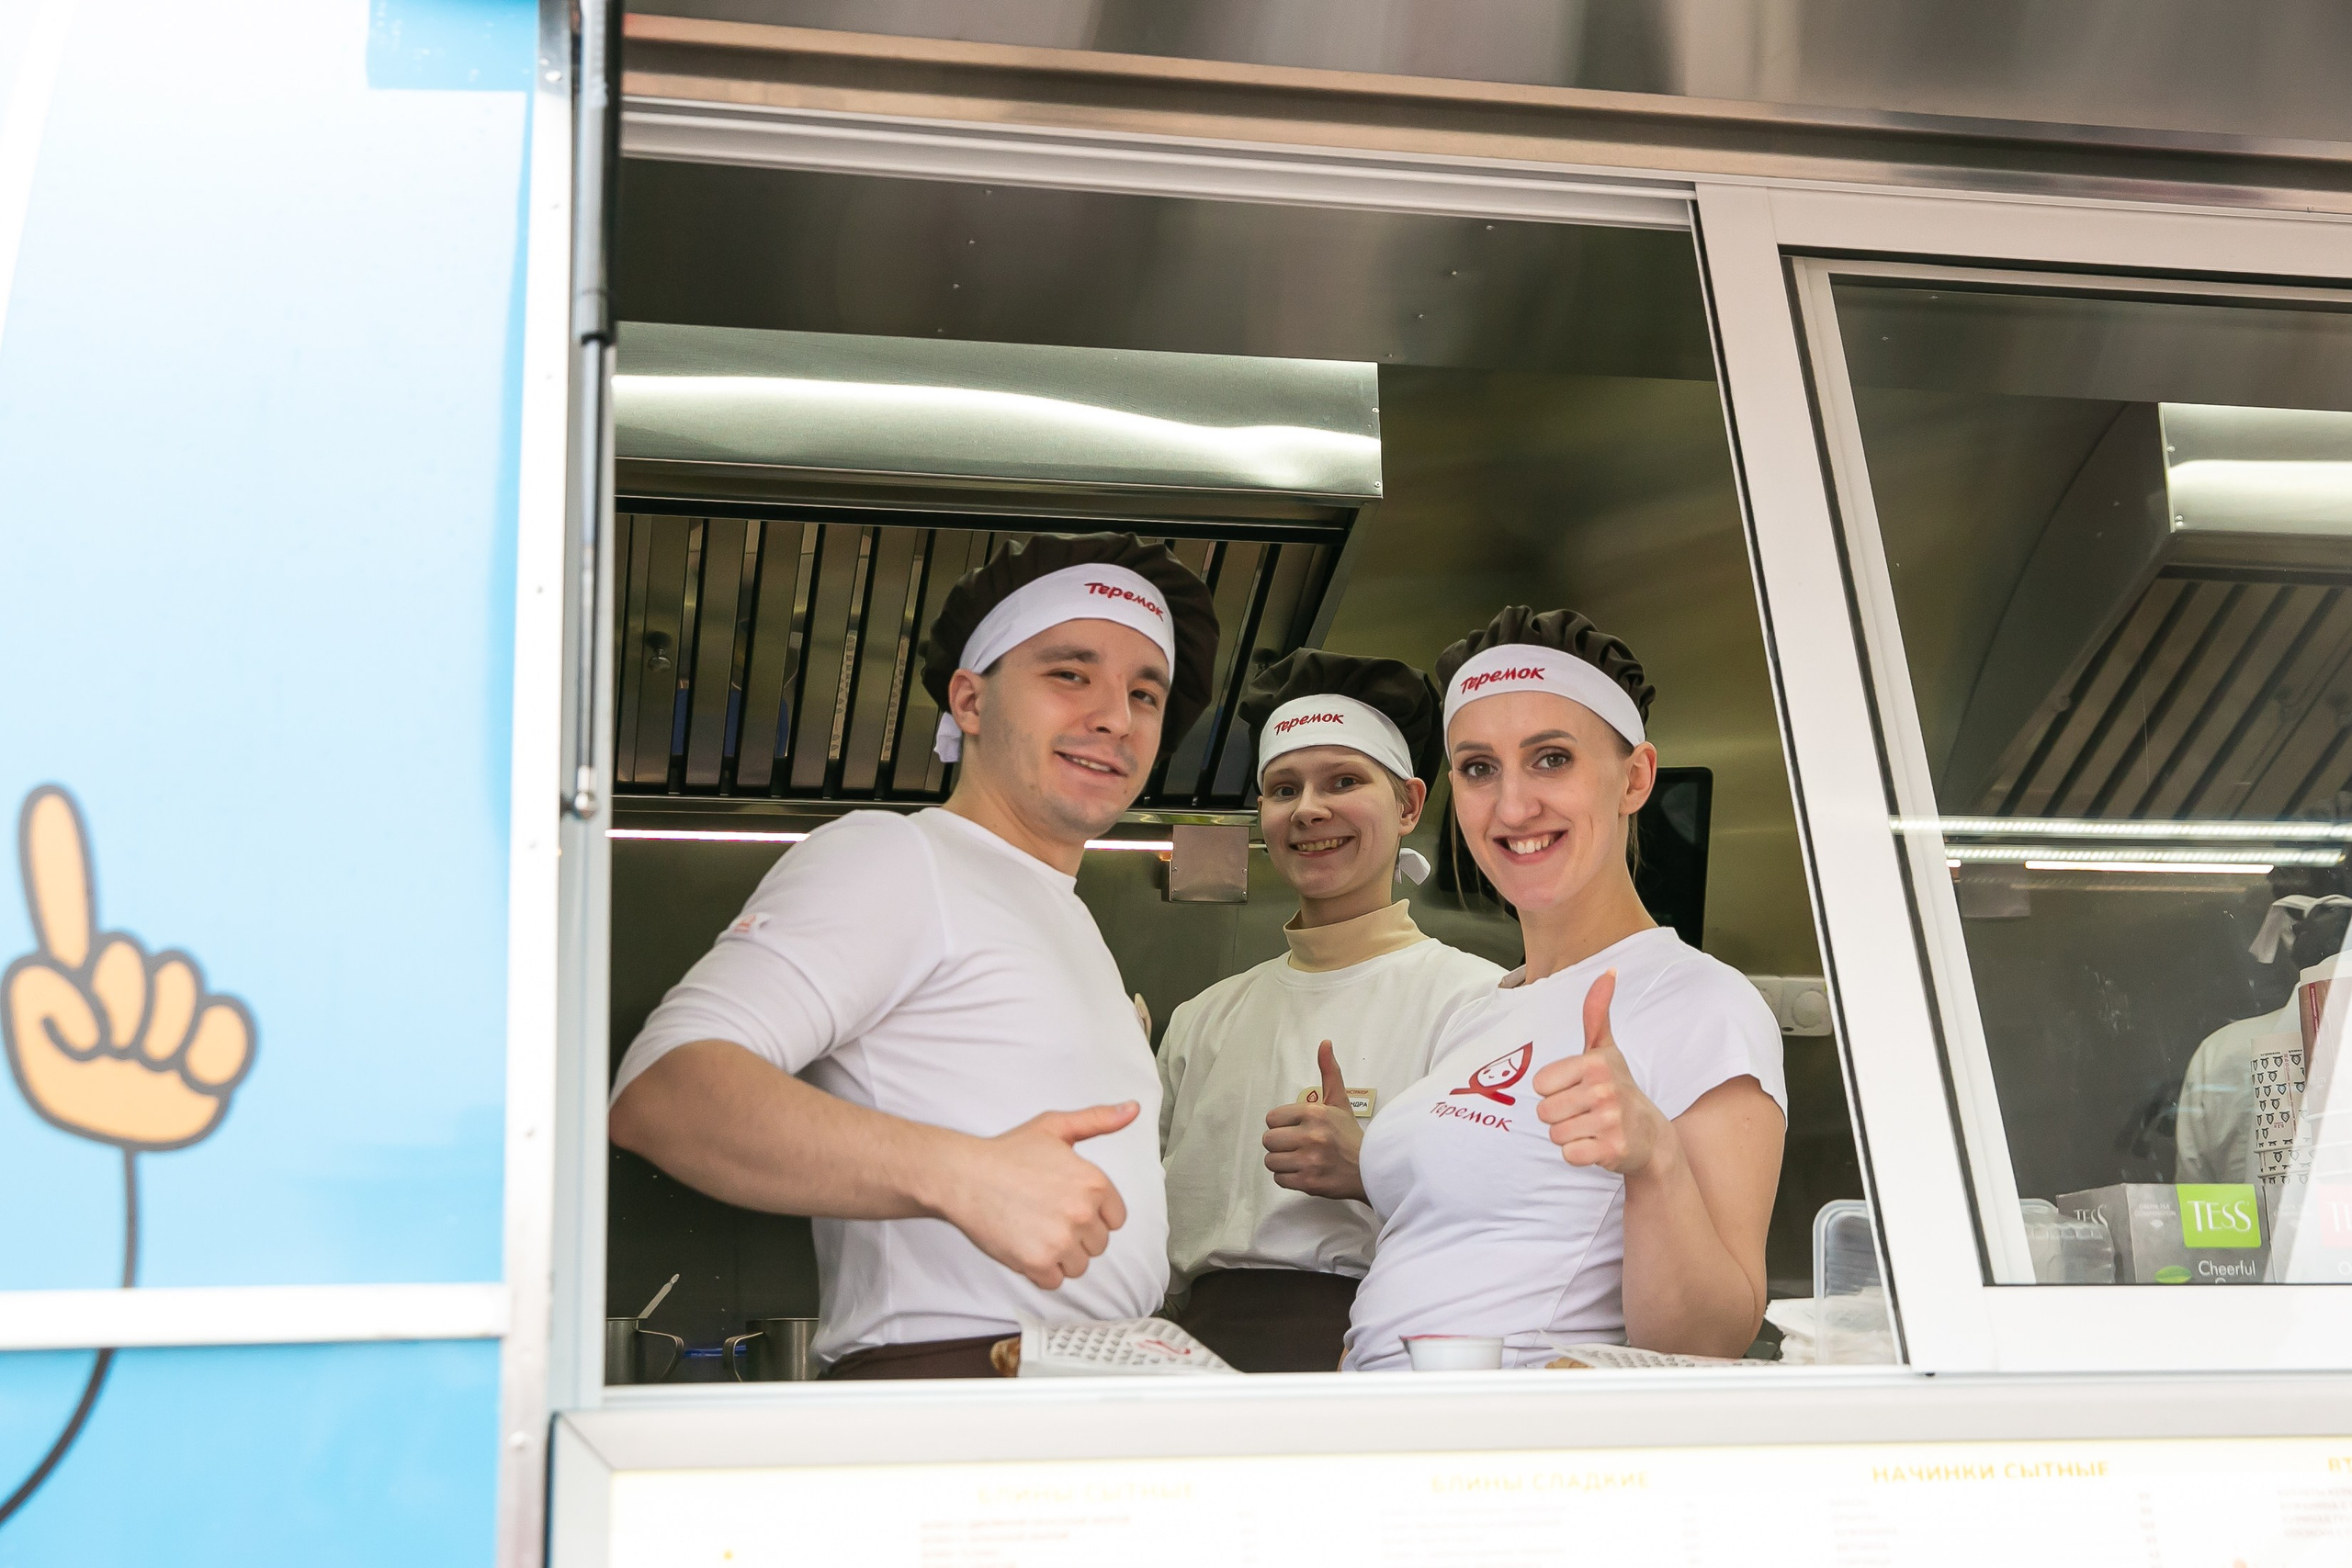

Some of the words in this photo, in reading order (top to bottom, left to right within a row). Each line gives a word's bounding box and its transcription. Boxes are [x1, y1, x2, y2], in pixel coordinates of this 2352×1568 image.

[1084, 582, 1164, 623] Теремок
[1457, 667, 1545, 694] Теремок
[1273, 713, 1344, 736] Теремок
[1430, 1101, 1512, 1132] Теремок
[2186, 1200, 2252, 1233] TESS
[2198, 1259, 2256, 1277] Cheerful
[1532, 1470, 1650, 1492] СЛАДКИЕ
[1871, 1463, 1996, 1483] НАЧИНКИ
[2003, 1460, 2110, 1479] СЫТНЫЕ
